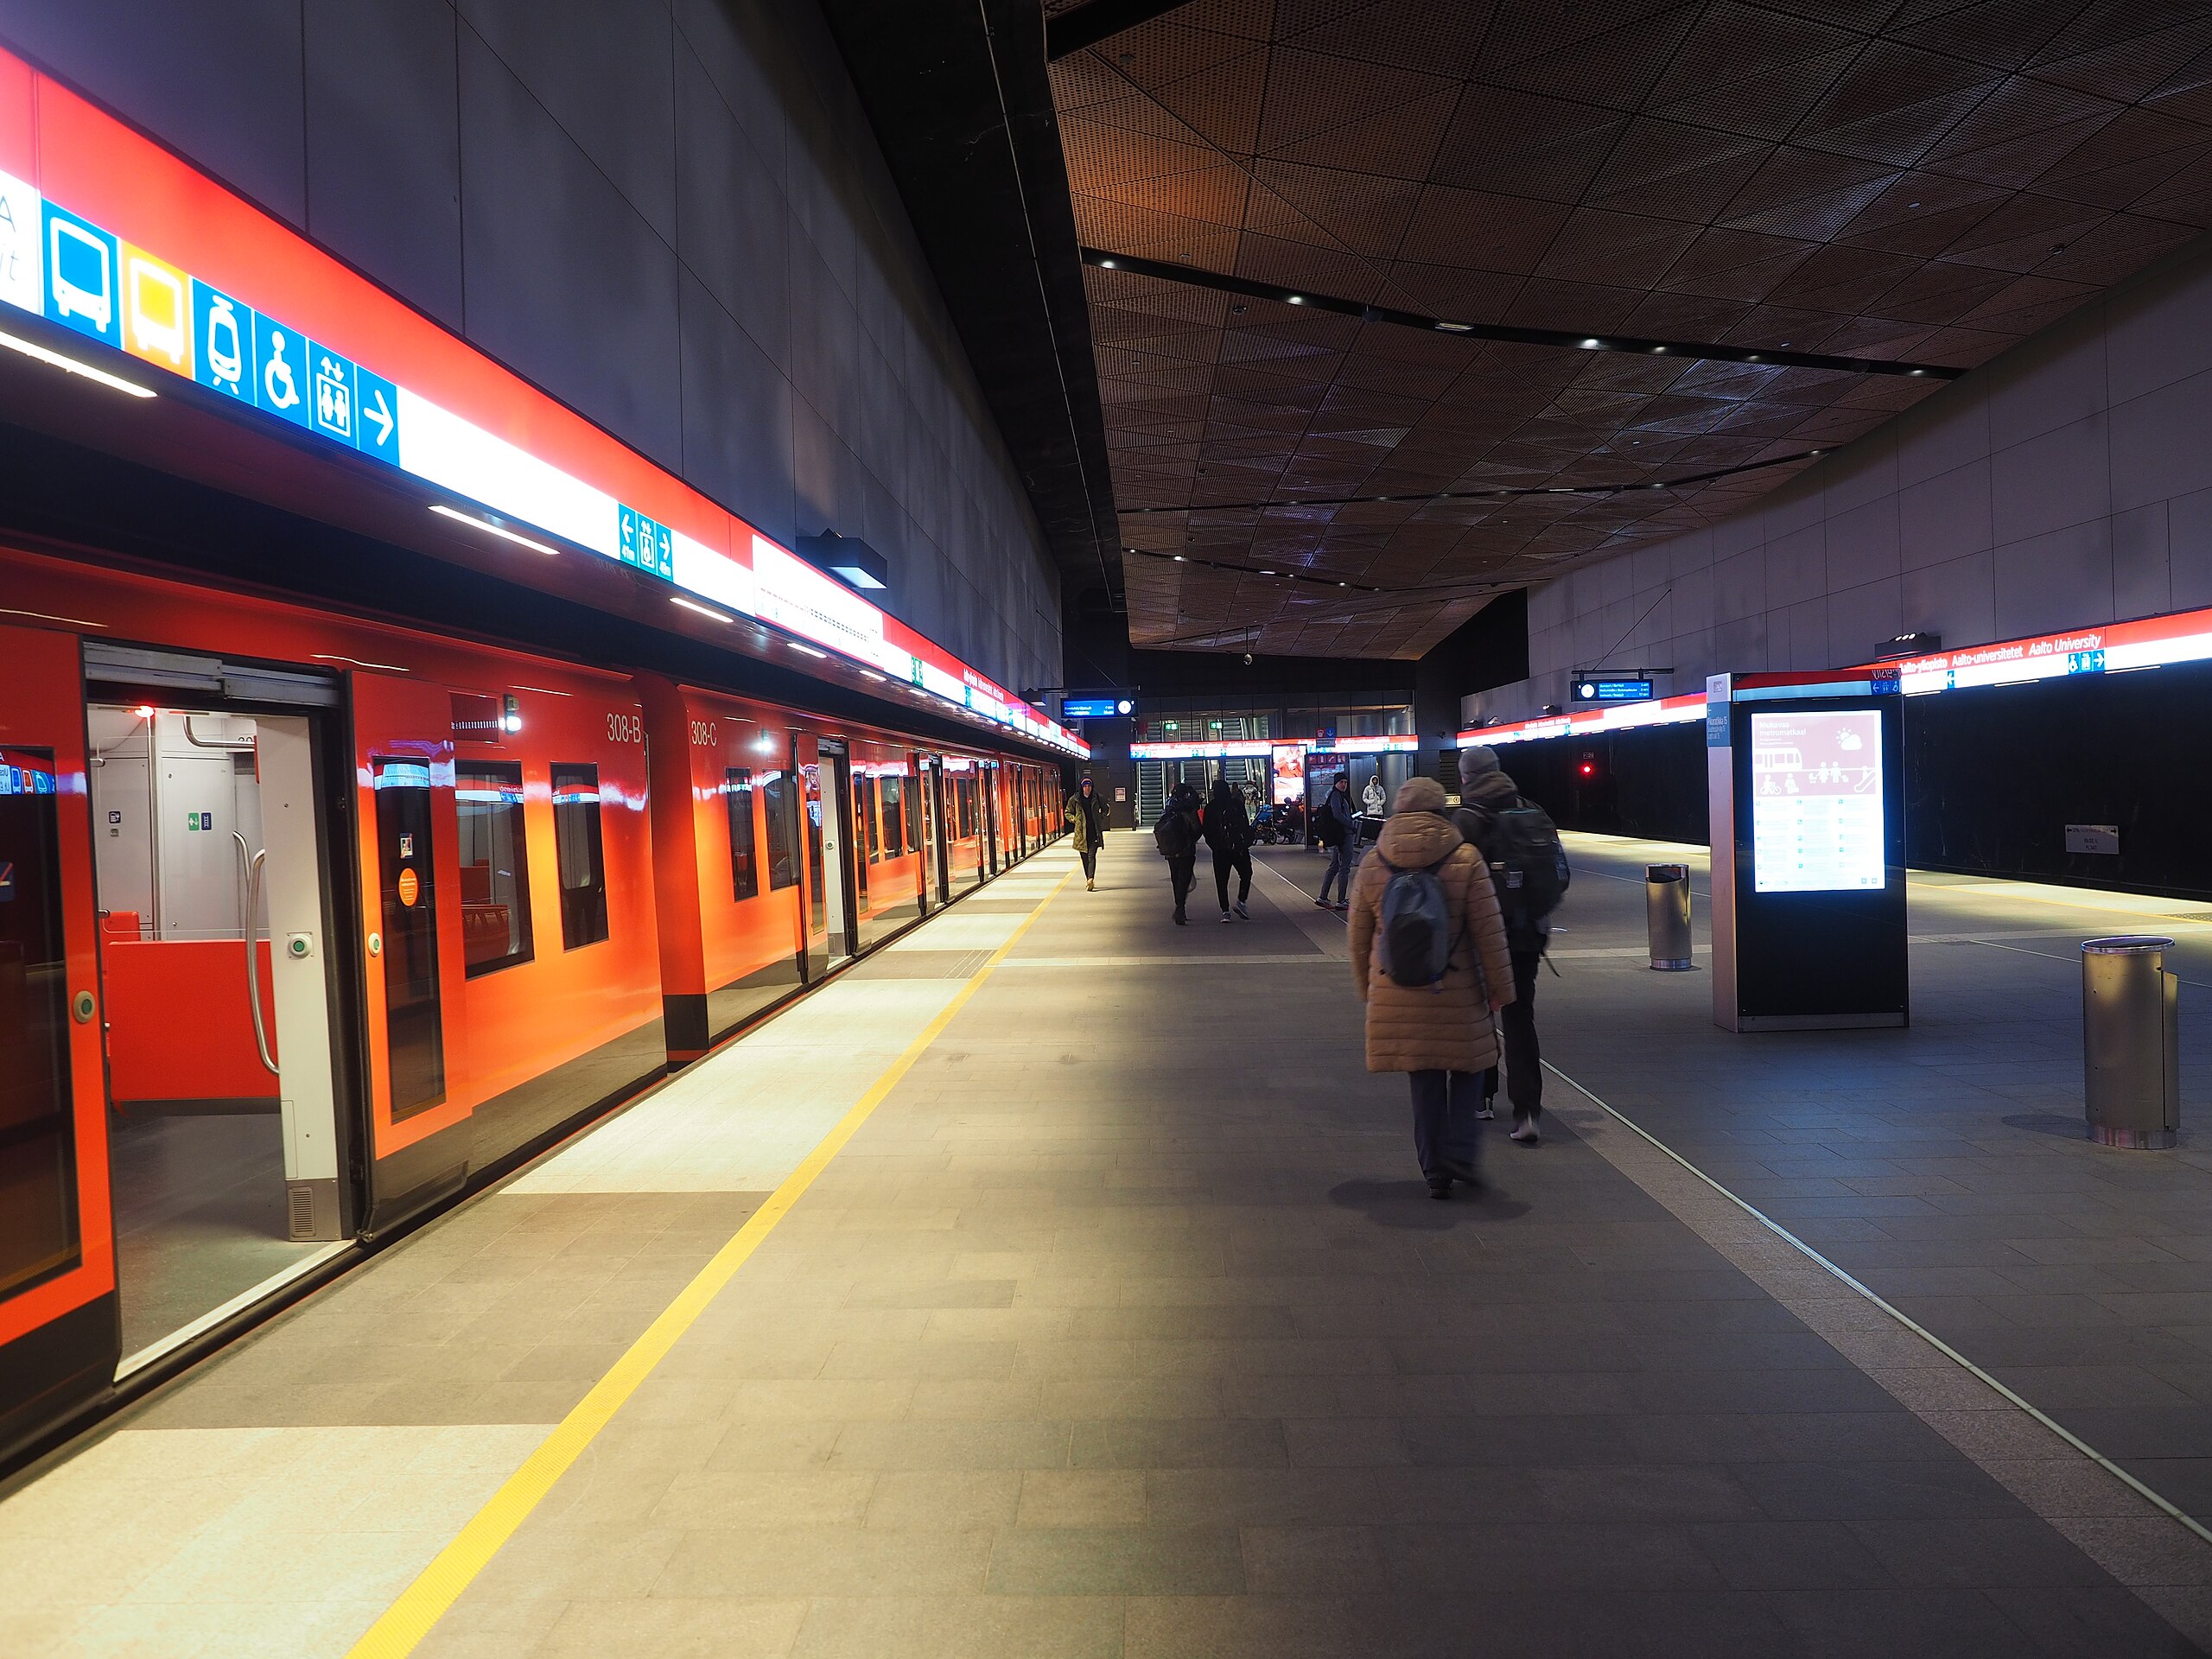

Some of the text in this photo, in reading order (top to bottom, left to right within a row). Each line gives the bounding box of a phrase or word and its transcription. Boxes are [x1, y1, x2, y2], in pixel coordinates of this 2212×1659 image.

[1951, 645, 2024, 667] Aalto-universitetet
[2029, 639, 2053, 657] Aalto
[2054, 633, 2102, 652] University
[607, 713, 641, 743] 308-B
[691, 720, 717, 747] 308-C
